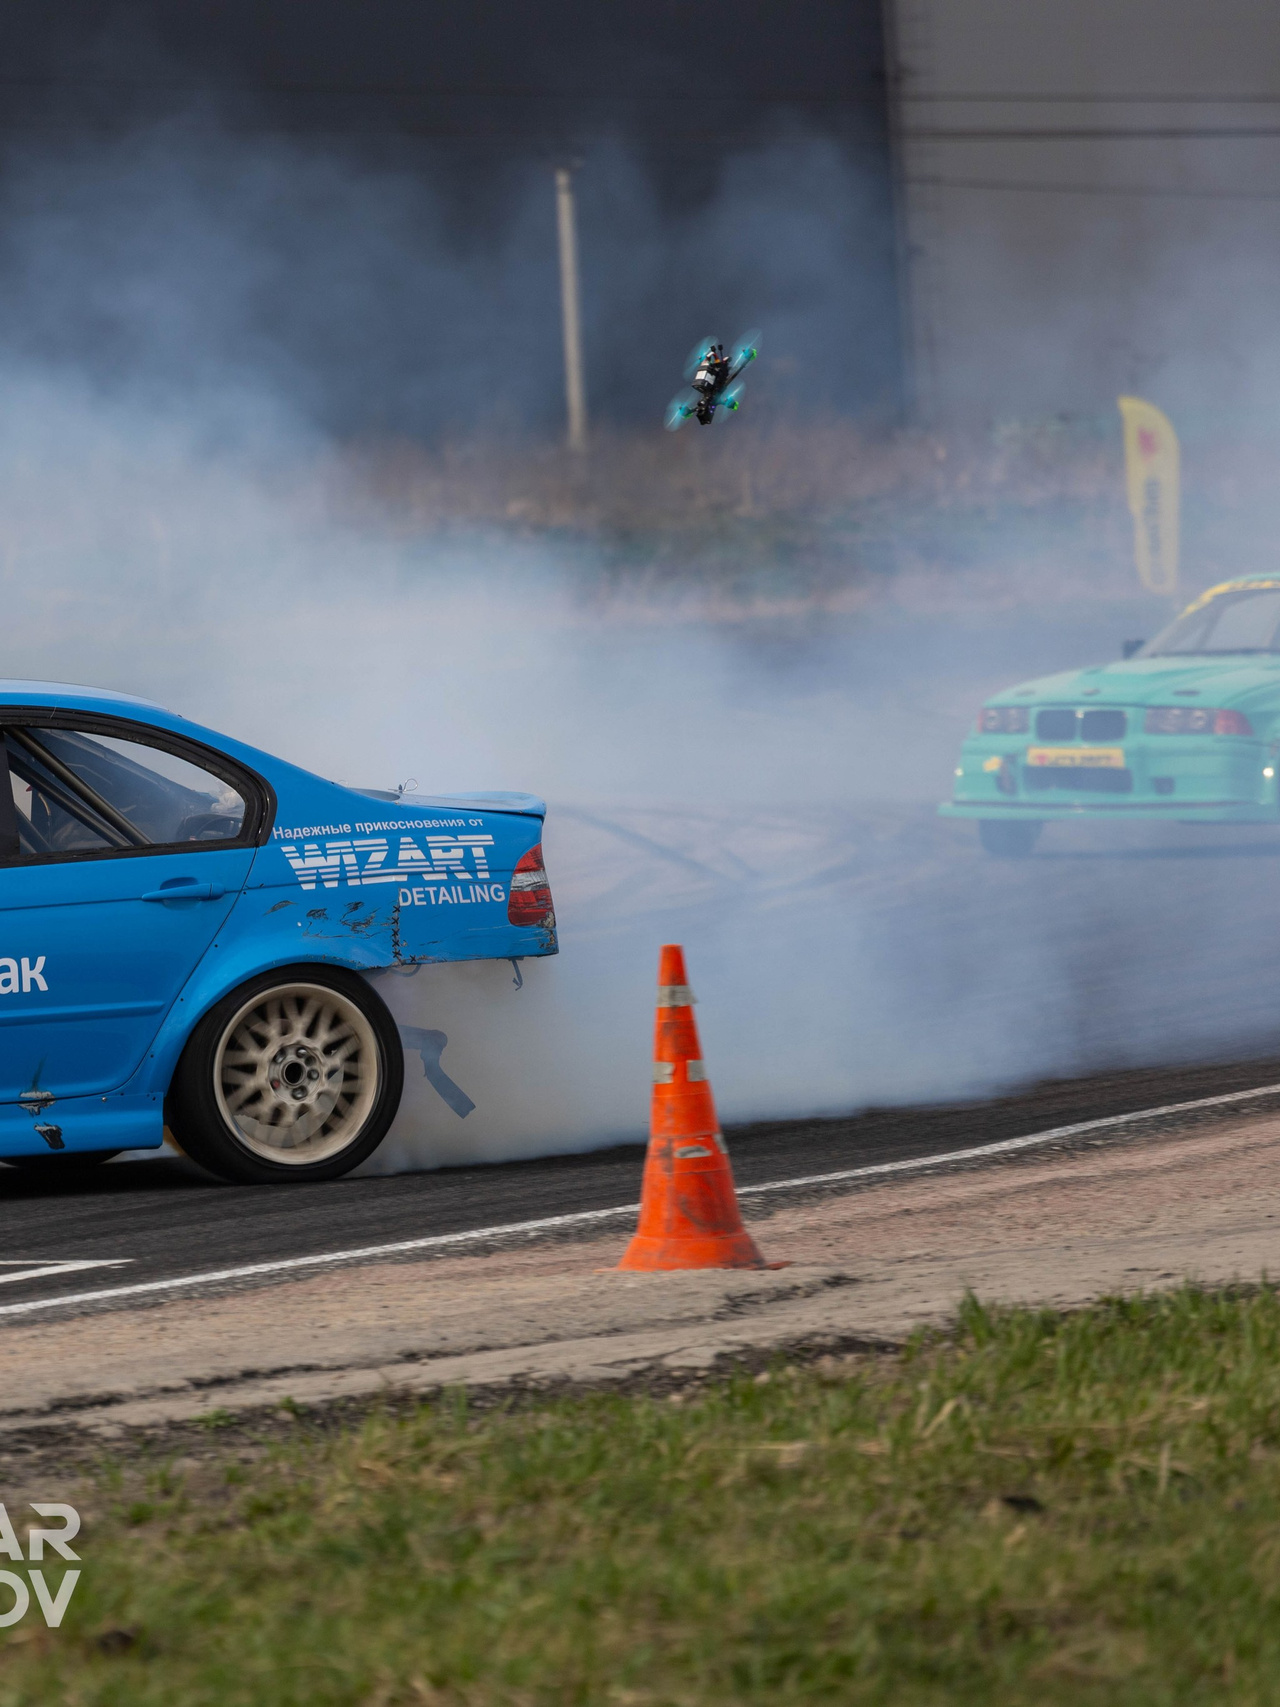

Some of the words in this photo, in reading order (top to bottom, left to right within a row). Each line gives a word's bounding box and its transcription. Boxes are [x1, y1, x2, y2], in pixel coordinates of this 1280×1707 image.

[272, 822, 352, 840] Надежные
[355, 818, 466, 834] прикосновения
[469, 818, 484, 827] от
[280, 834, 495, 891] WIZART
[398, 883, 506, 907] DETAILING
